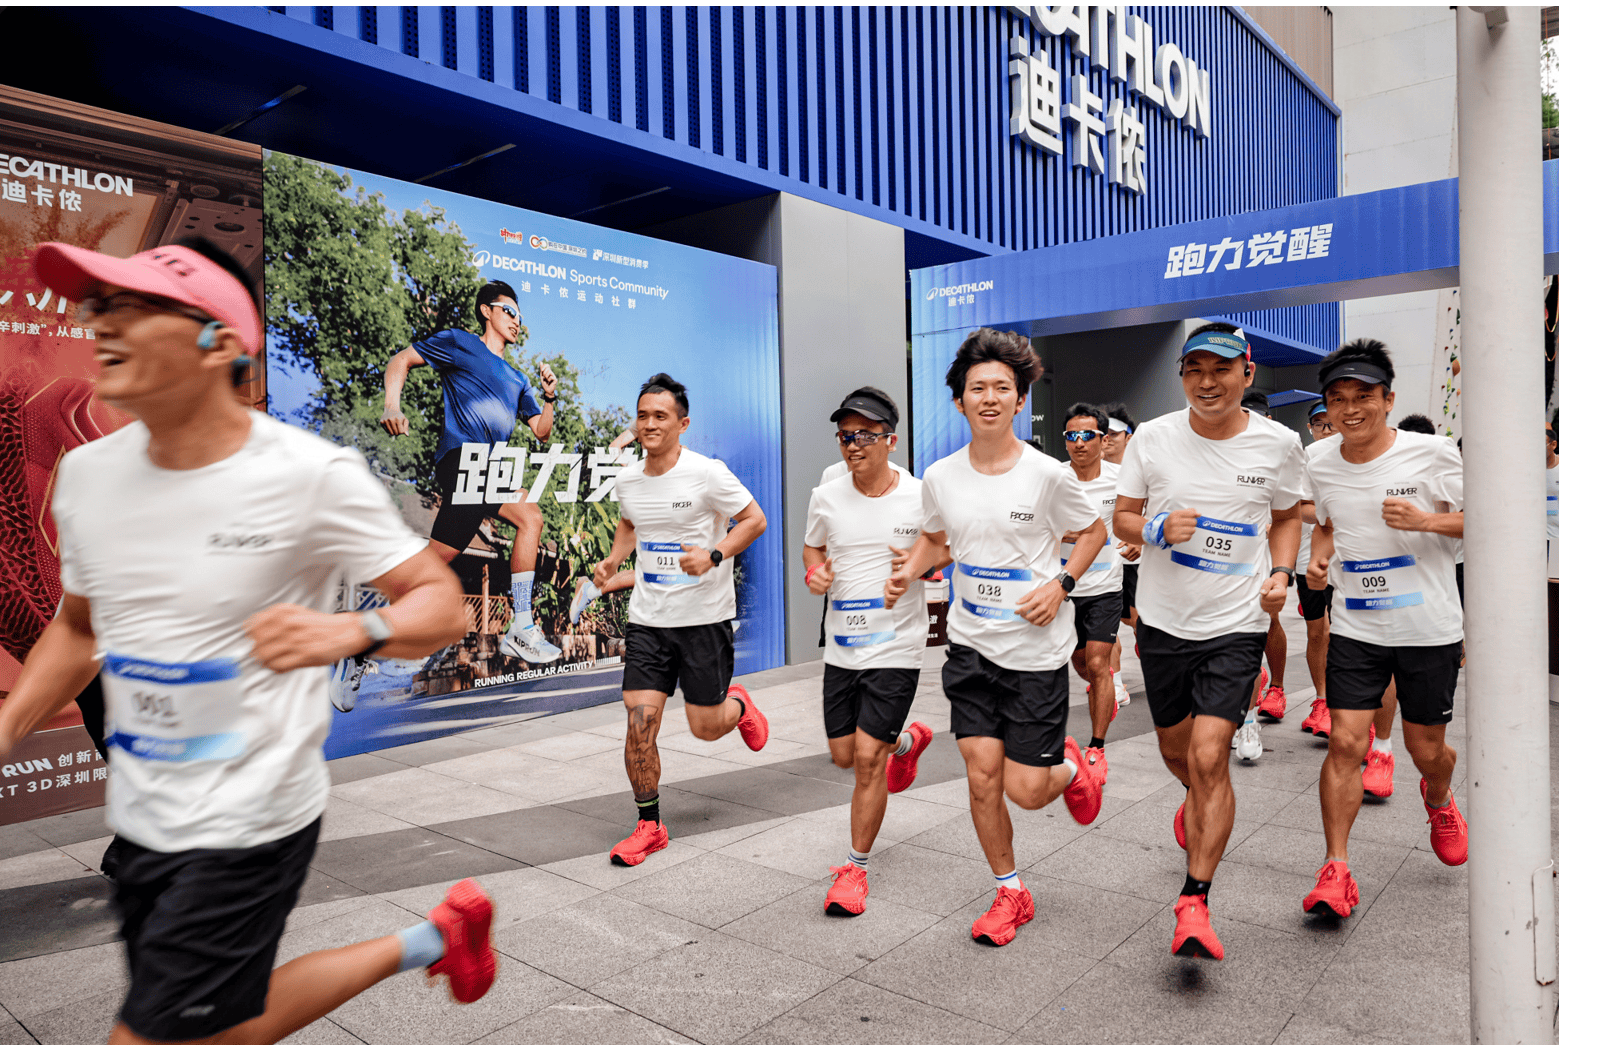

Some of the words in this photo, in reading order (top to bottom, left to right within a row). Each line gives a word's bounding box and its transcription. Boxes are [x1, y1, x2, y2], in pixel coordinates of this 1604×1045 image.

[1009, 35, 1146, 196] 迪卡侬
[2, 178, 82, 212] 迪卡侬
[1164, 223, 1334, 279] 跑力觉醒
[492, 254, 567, 280] DECATHLON
[569, 269, 608, 288] Sports
[609, 276, 669, 300] Community
[939, 280, 994, 297] DECATHLON
[1010, 511, 1034, 521] PACER
[1210, 522, 1244, 532] DECATHLON
[1205, 536, 1232, 551] 035
[656, 556, 675, 566] 011
[1362, 576, 1386, 587] 009
[978, 583, 1002, 597] 038
[846, 615, 867, 626] 008
[474, 674, 514, 688] RUNNING
[516, 666, 556, 680] REGULAR
[557, 660, 593, 674] ACTIVITY
[1, 758, 54, 778] RUN
